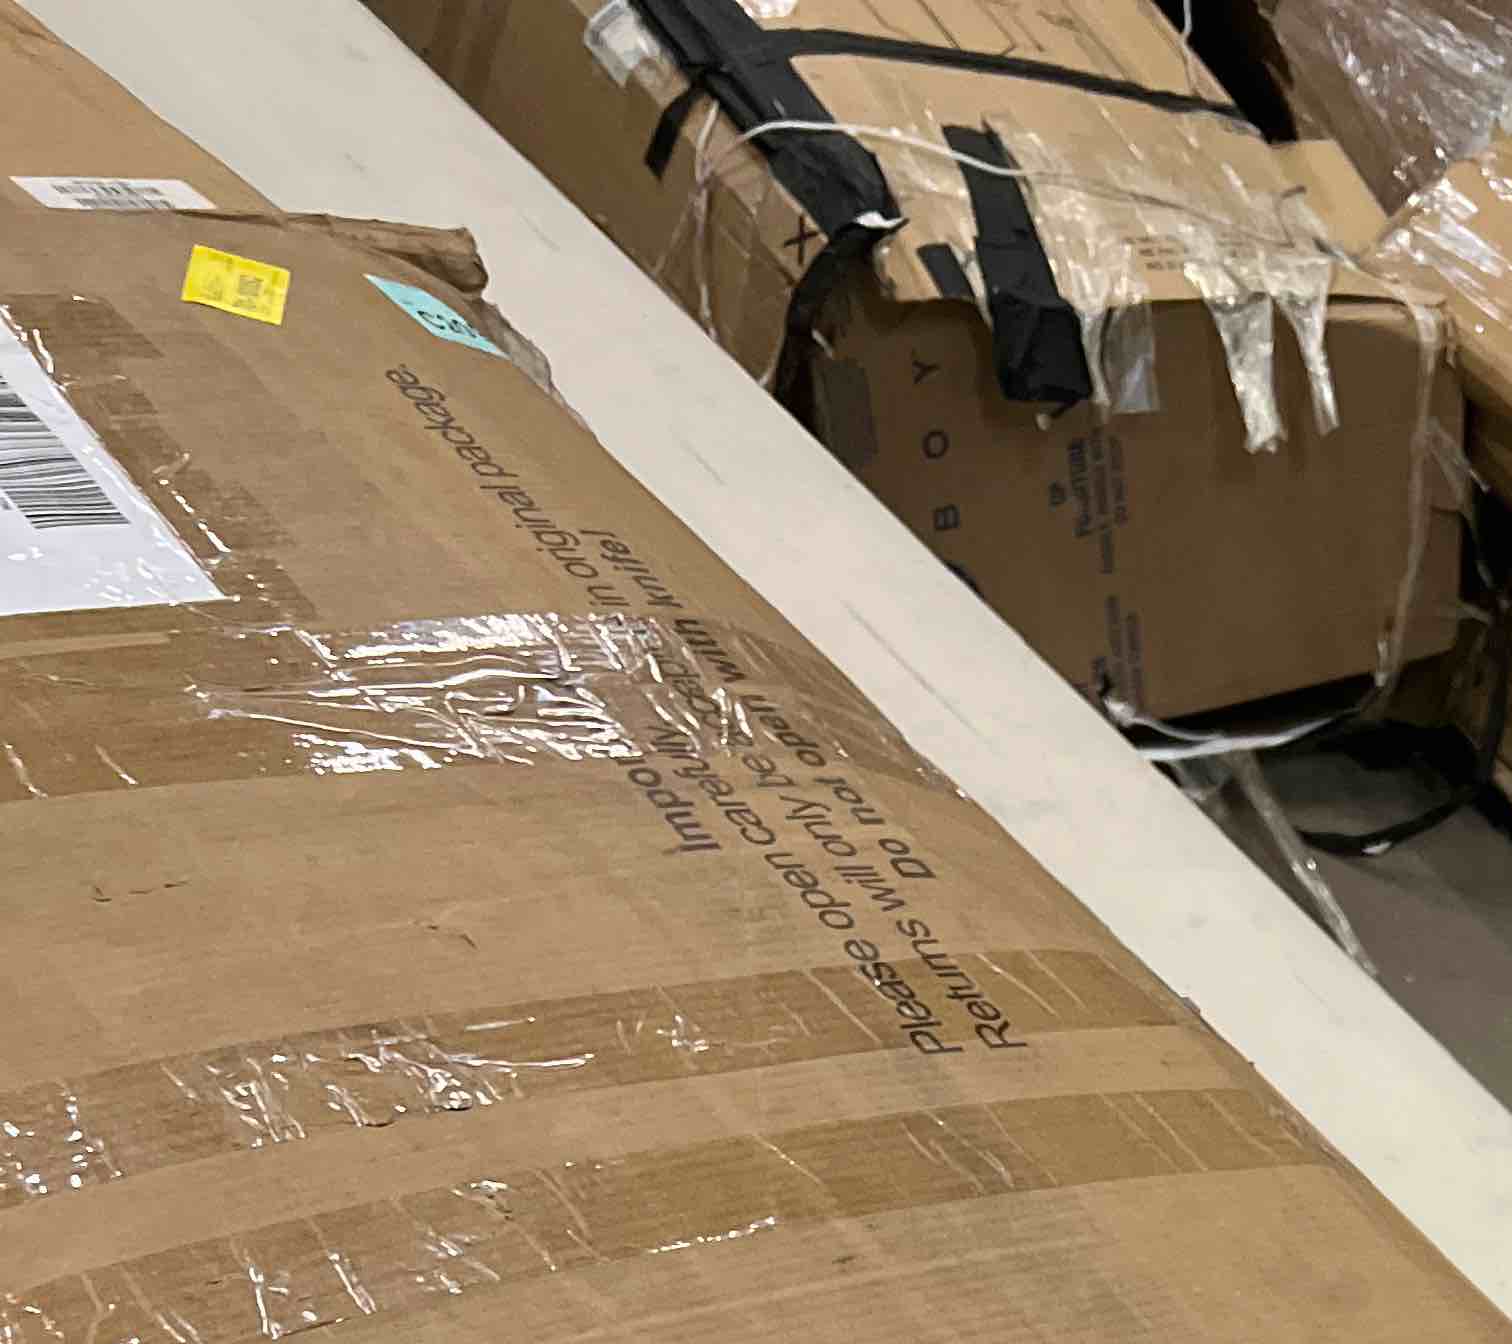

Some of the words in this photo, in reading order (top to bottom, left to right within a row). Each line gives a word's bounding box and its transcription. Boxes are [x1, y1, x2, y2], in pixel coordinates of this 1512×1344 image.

[480, 482, 599, 578] original
[579, 528, 683, 608] knife!
[587, 585, 630, 606] in
[675, 618, 746, 682] with
[740, 694, 826, 767] open
[743, 754, 796, 788] be
[813, 775, 884, 825] not
[779, 794, 857, 857] only
[764, 852, 854, 930] open
[834, 866, 906, 911] will
[879, 838, 936, 880] Do
[844, 939, 962, 1055] Please
[896, 918, 1028, 1049] Returns
